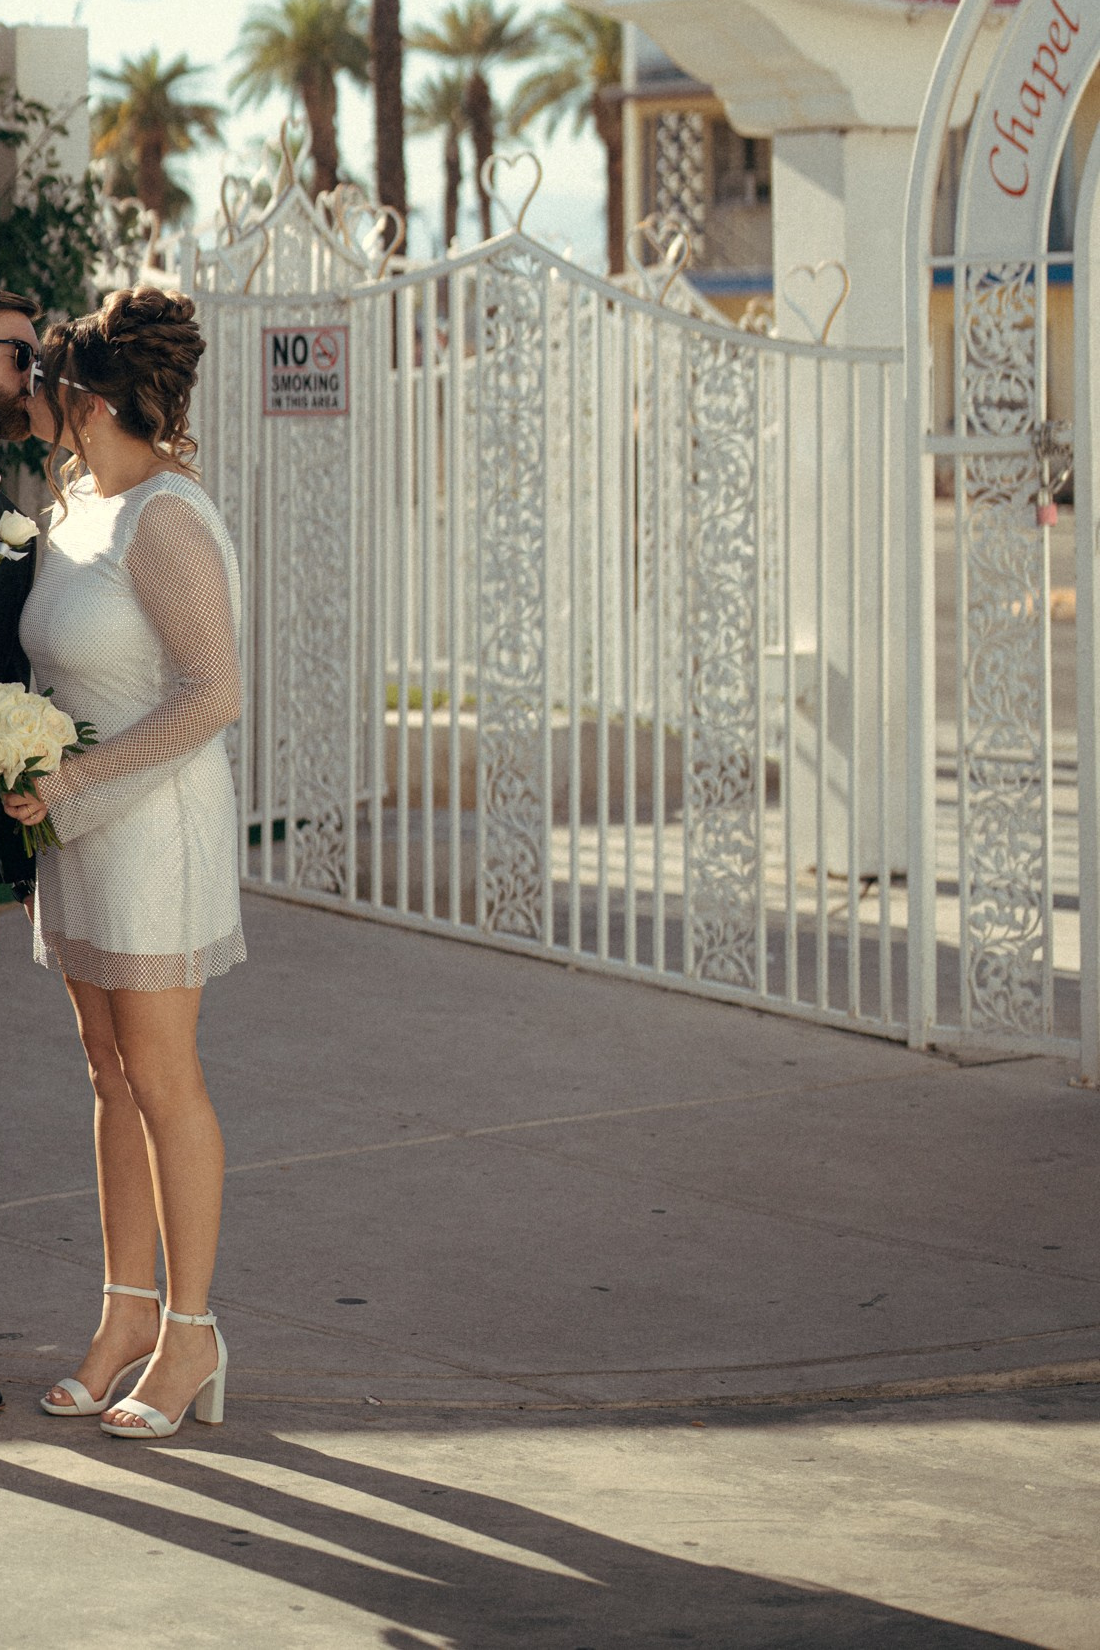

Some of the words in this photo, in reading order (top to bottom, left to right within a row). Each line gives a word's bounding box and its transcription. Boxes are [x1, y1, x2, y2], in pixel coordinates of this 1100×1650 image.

[273, 334, 308, 367] NO
[272, 374, 339, 392] SMOKING
[272, 396, 282, 408] IN
[286, 395, 308, 408] THIS
[311, 395, 338, 408] AREA
